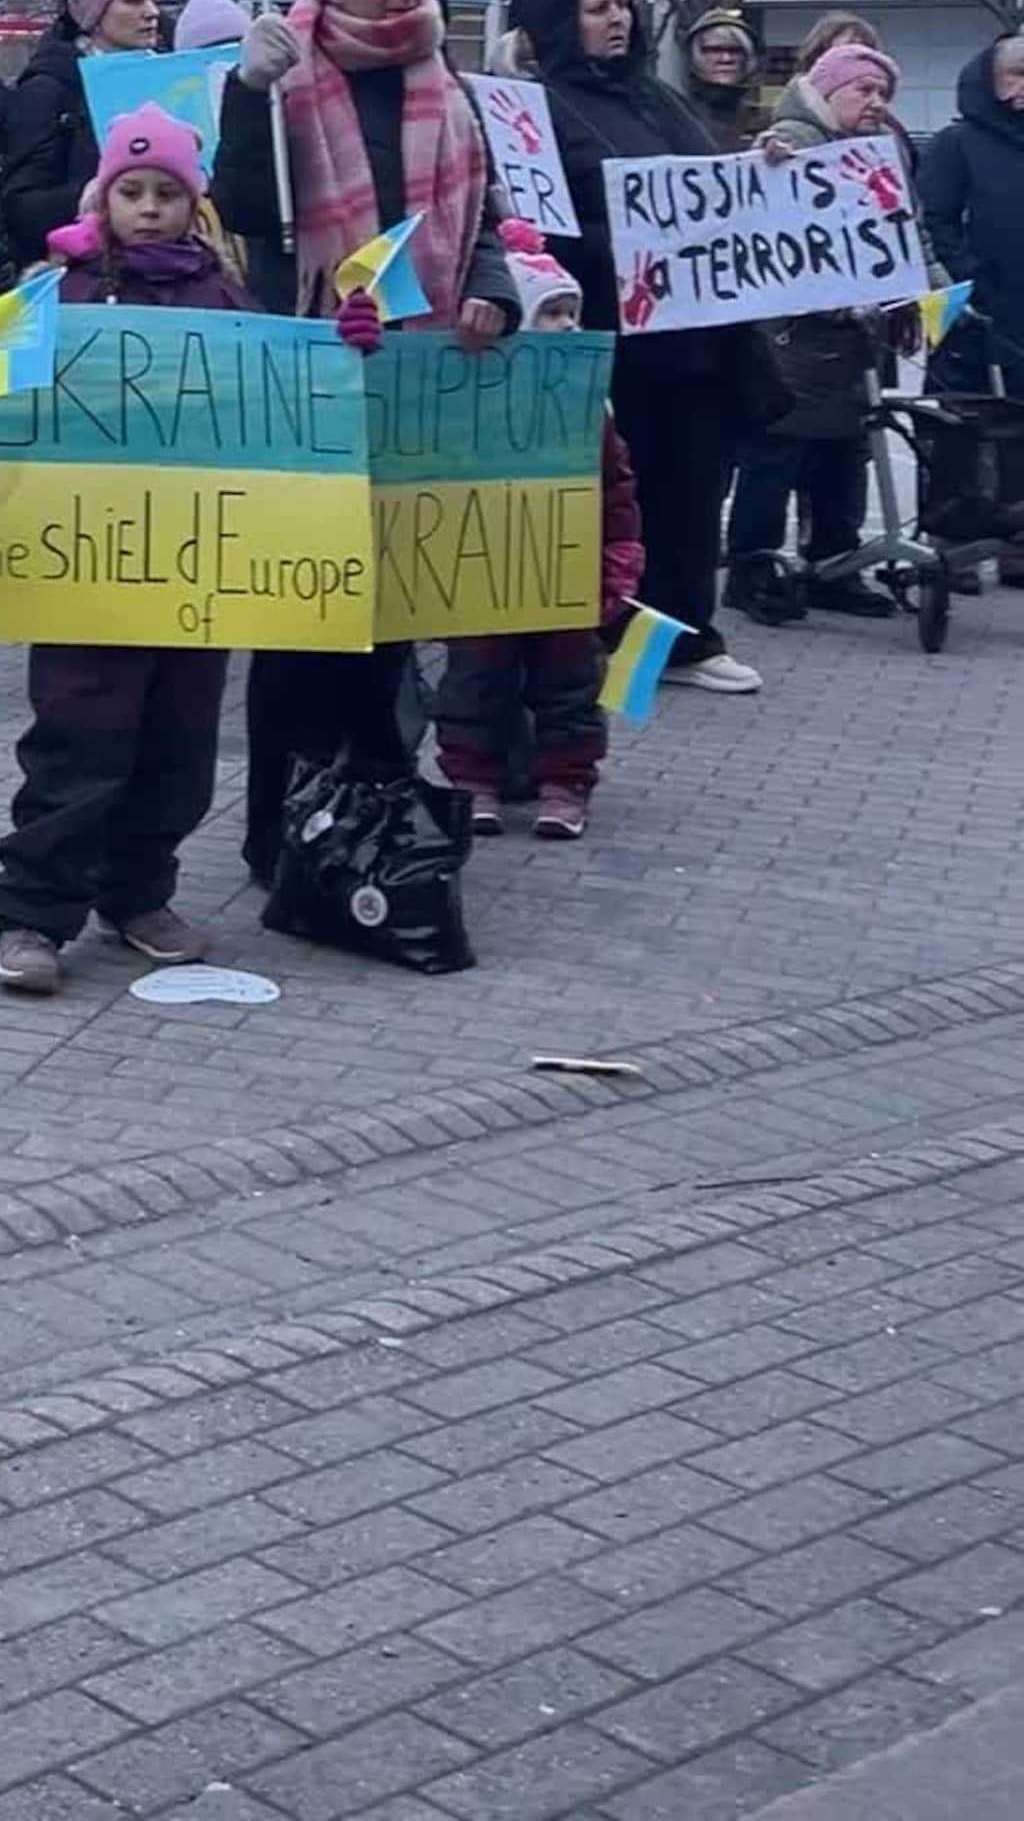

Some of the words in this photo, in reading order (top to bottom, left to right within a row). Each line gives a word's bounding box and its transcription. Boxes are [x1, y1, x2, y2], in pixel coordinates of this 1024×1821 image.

[678, 208, 914, 303] TERRORIST
[216, 489, 365, 622] Europe
[373, 482, 594, 617] KRAINE
[178, 592, 215, 644] of
